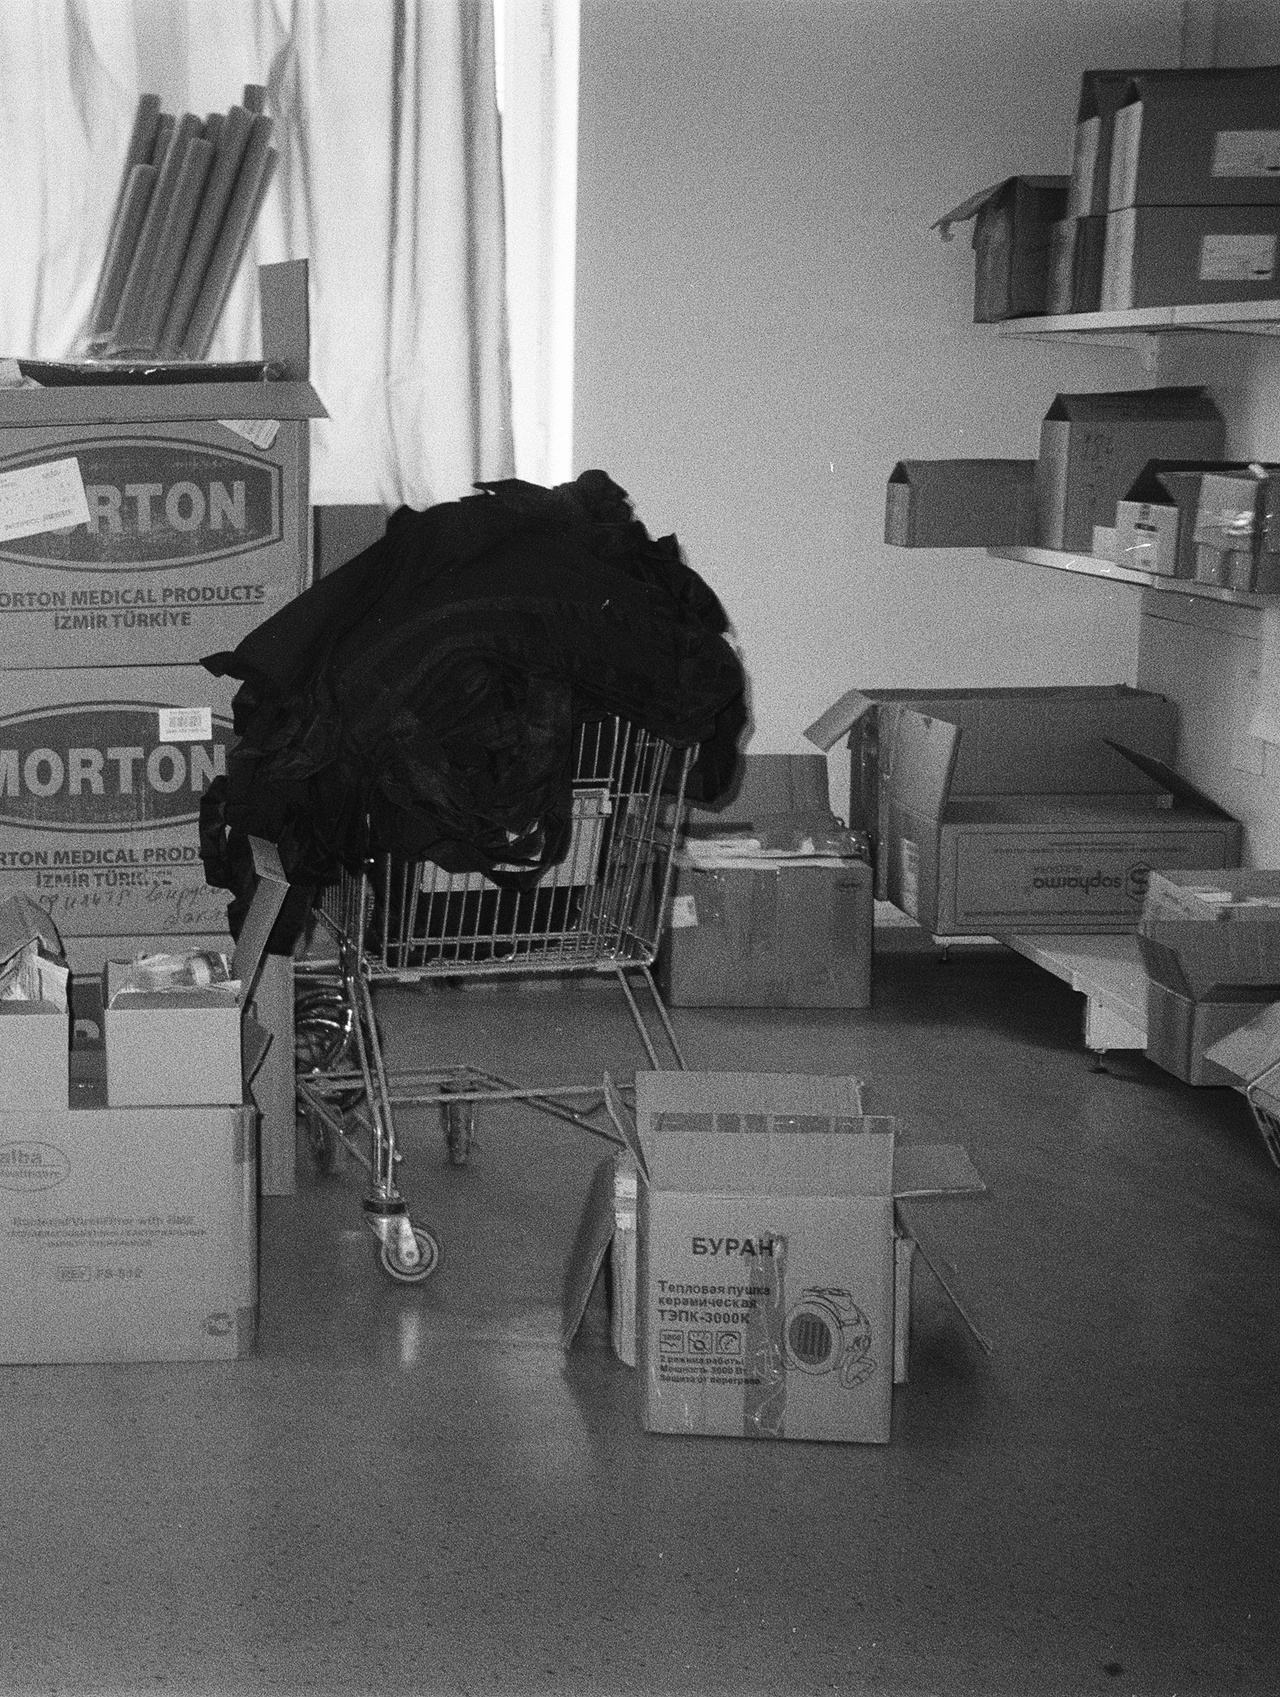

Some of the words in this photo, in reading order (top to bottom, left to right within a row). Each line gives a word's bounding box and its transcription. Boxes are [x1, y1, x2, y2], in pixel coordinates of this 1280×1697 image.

[71, 588, 158, 605] MEDICAL
[162, 585, 266, 603] PRODUCTS
[111, 610, 192, 628] TÜRKİYE
[53, 849, 139, 865] MEDICAL
[143, 847, 202, 863] PROD
[1033, 871, 1122, 895] sopharma
[692, 1237, 774, 1257] БУРАН
[658, 1280, 725, 1296] Тепловая
[727, 1285, 771, 1297] пушка
[658, 1297, 757, 1309] керамическая
